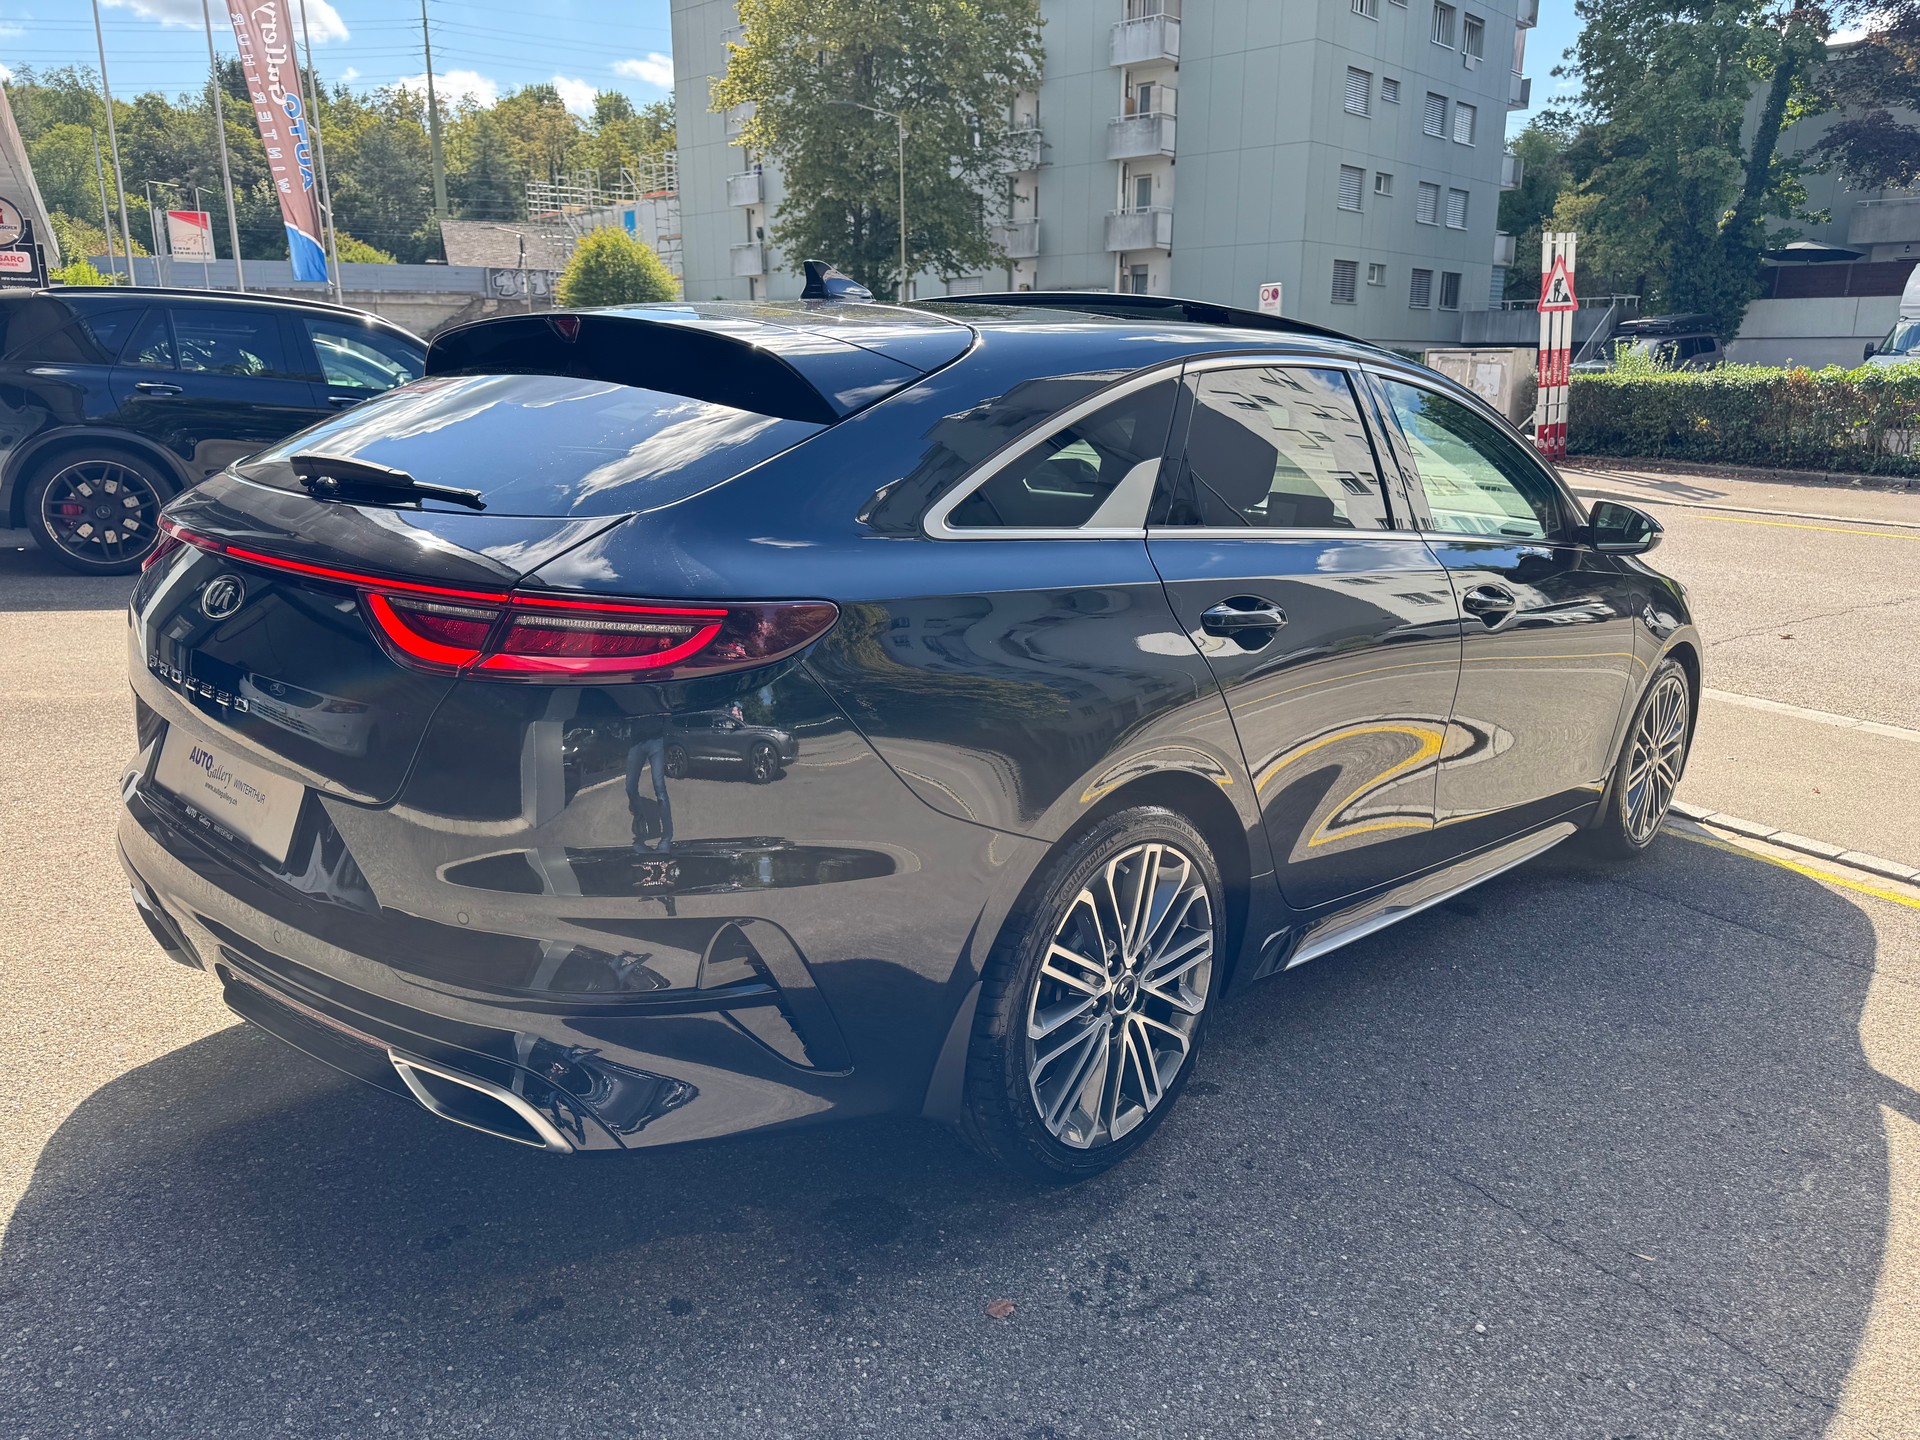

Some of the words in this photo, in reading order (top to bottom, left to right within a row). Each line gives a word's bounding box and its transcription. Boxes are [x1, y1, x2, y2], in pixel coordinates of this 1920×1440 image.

[189, 746, 214, 771] AUTO
[206, 765, 233, 789] Gallery
[233, 778, 266, 804] WINTERTHUR
[204, 782, 238, 806] www.autogallery.ch
[184, 805, 197, 818] AUTO
[1059, 843, 1109, 902] Continental
